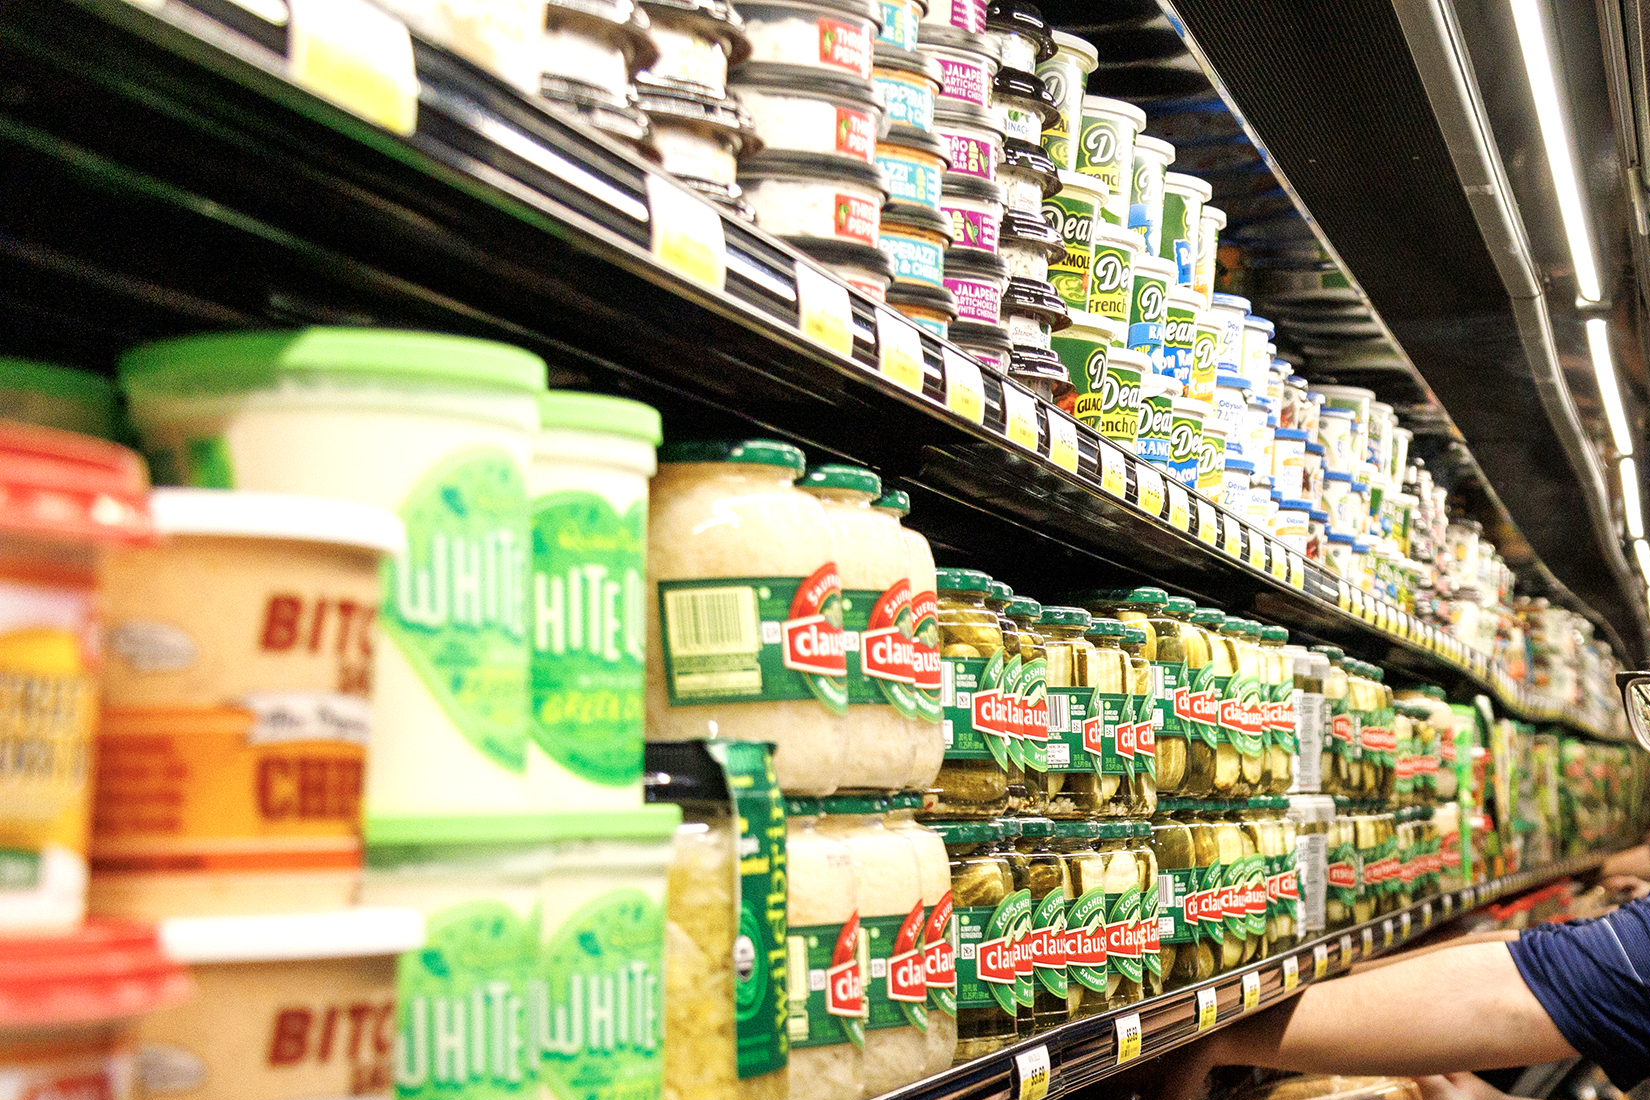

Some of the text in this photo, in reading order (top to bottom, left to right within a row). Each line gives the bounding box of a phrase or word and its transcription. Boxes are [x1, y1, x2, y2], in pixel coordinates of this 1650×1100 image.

[968, 140, 979, 172] DIP
[952, 210, 965, 242] DIP
[1088, 299, 1128, 315] French
